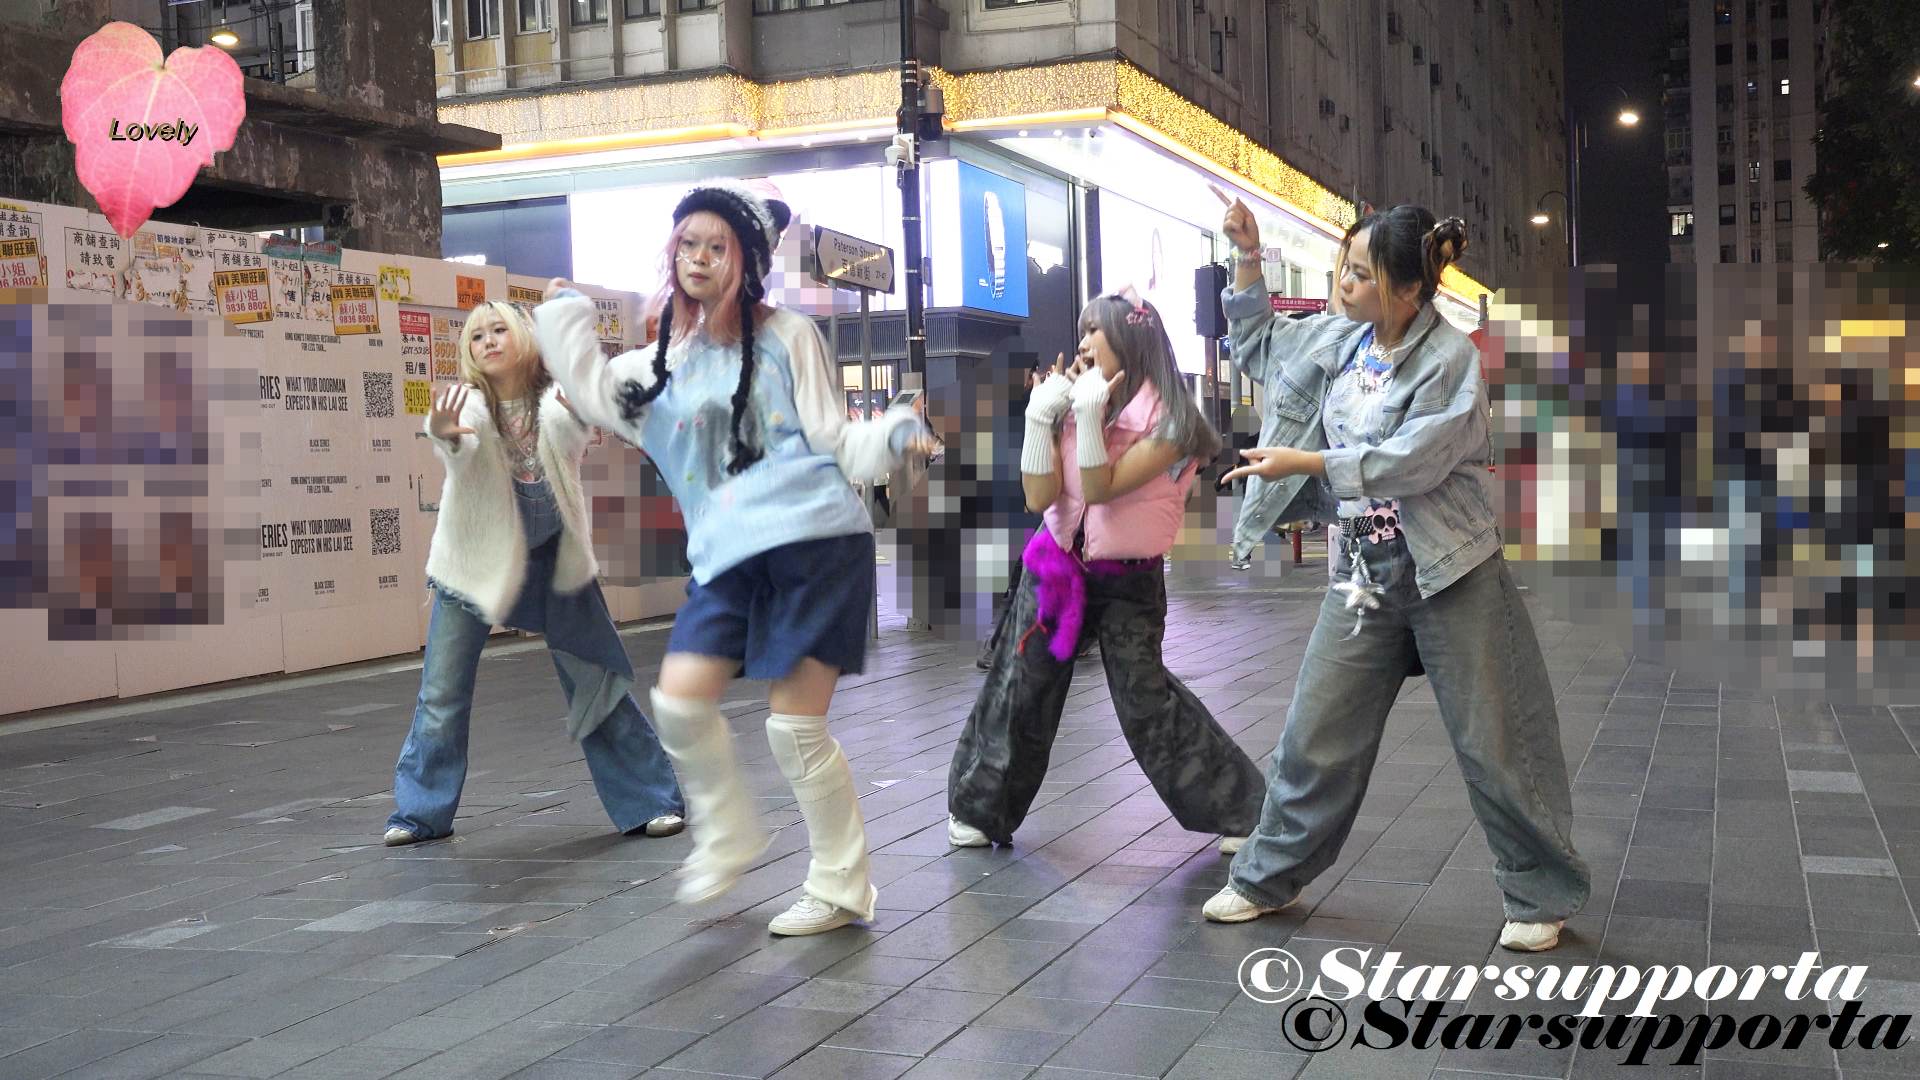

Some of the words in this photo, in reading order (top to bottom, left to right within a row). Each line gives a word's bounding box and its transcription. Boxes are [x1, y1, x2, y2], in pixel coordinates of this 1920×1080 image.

[833, 238, 858, 256] Paterson
[80, 252, 115, 269] 請致電
[226, 303, 246, 312] 9836
[248, 301, 267, 311] 8802
[260, 376, 281, 400] RIES
[285, 376, 301, 392] WHAT
[303, 377, 318, 393] YOUR
[318, 377, 347, 393] DOORMAN
[285, 395, 311, 410] EXPECTS
[311, 395, 318, 411] IN
[318, 395, 328, 411] HIS
[328, 396, 338, 411] LAI
[338, 396, 349, 411] SEE
[262, 524, 288, 548] ERIES
[290, 520, 307, 536] WHAT
[308, 519, 323, 535] YOUR
[323, 518, 352, 534] DOORMAN
[290, 538, 315, 555] EXPECTS
[316, 538, 323, 553] IN
[323, 537, 333, 553] HIS
[333, 536, 343, 552] LAI
[343, 535, 353, 551] SEE
